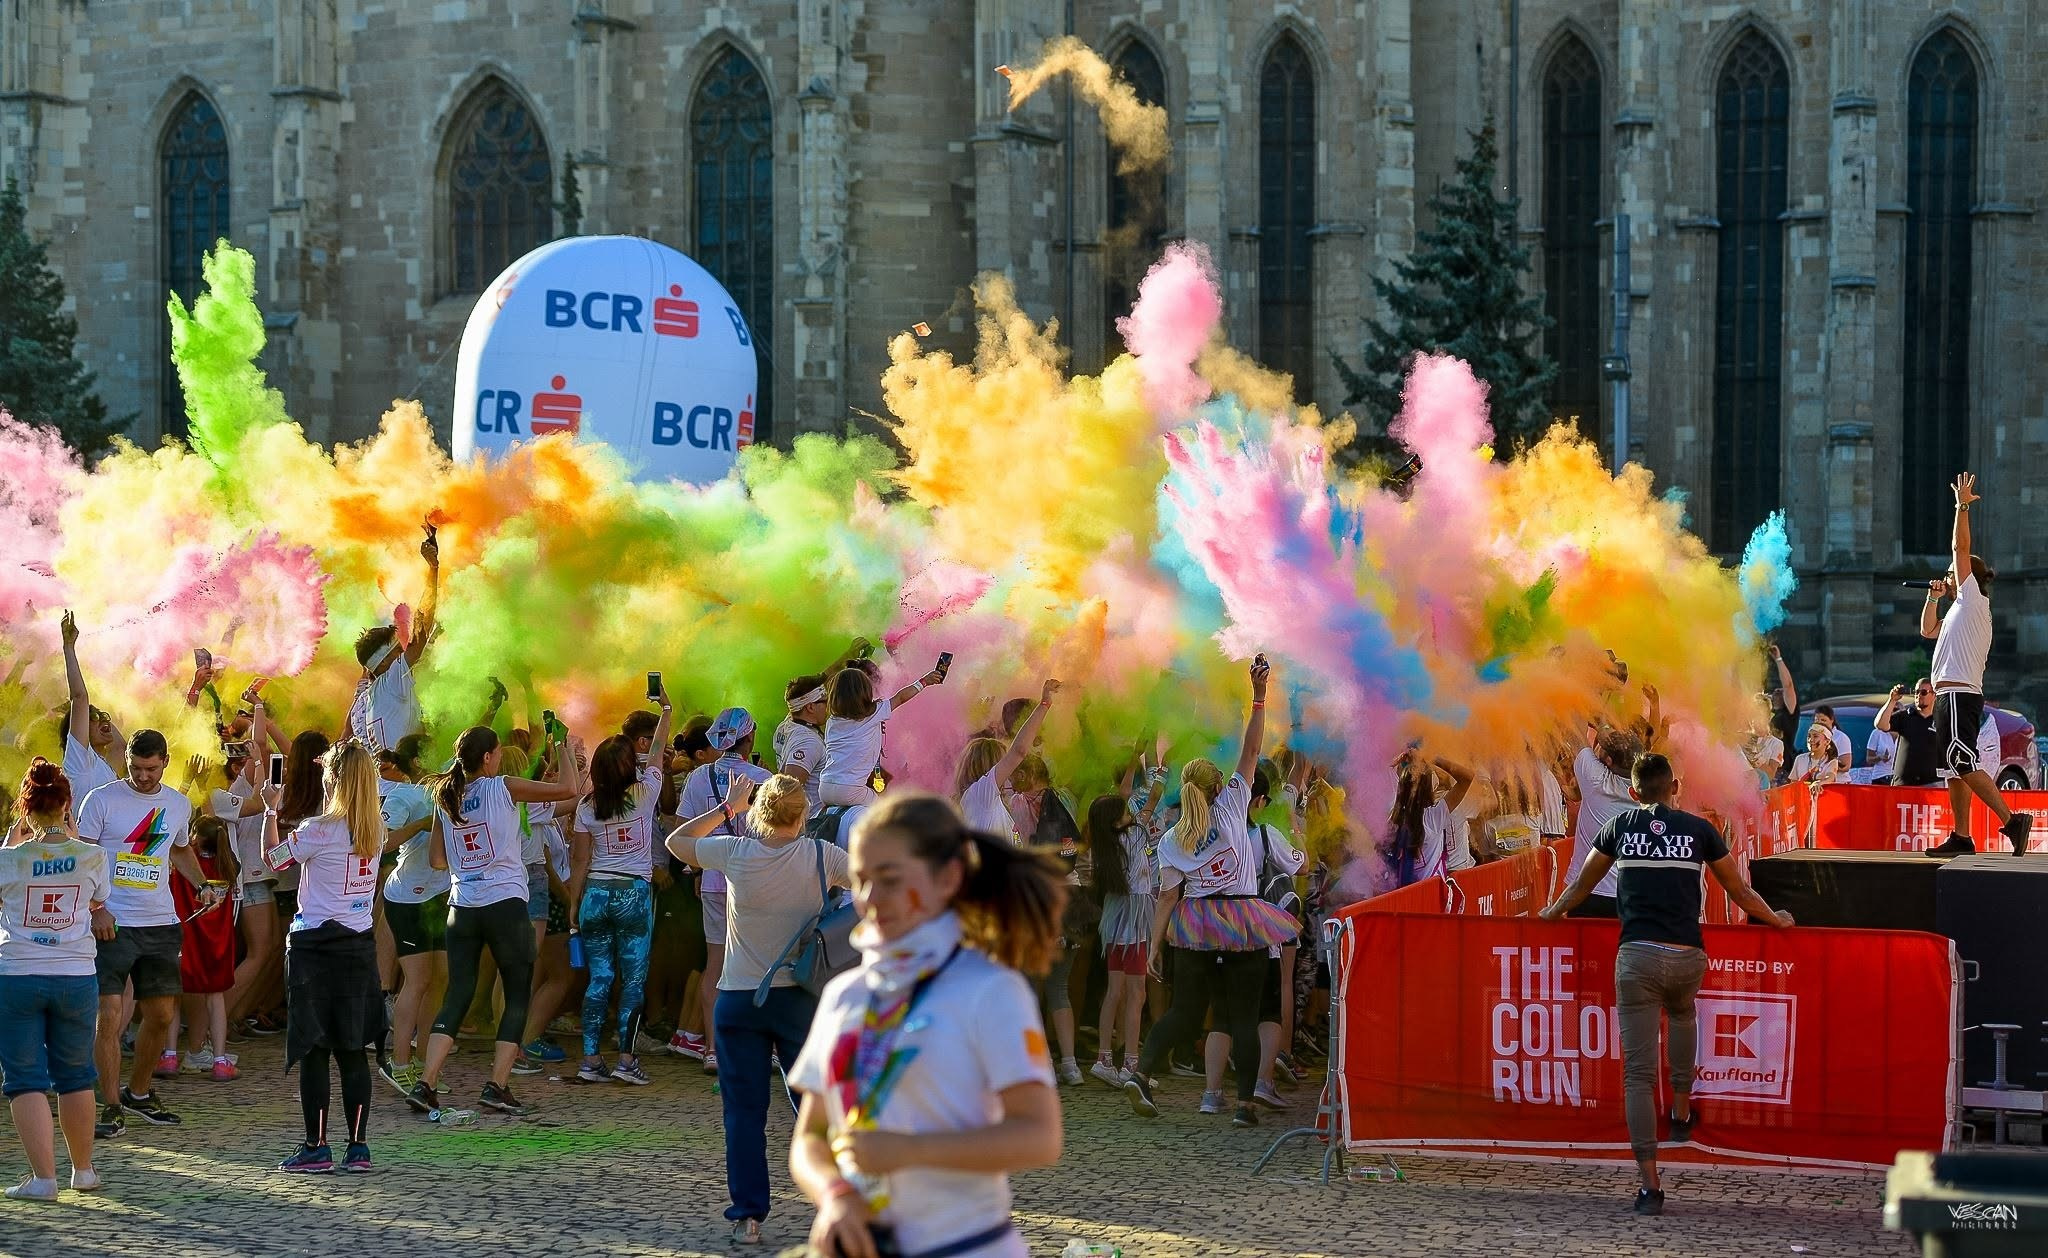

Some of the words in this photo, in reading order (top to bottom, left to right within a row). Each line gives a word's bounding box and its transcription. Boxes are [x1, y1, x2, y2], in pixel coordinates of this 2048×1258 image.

[545, 289, 643, 333] BCR
[475, 389, 521, 434] CR
[652, 401, 733, 451] BCR
[1897, 803, 1942, 835] THE
[1621, 843, 1693, 858] GUARD
[1623, 832, 1652, 846] ML
[1662, 835, 1694, 847] VIP
[33, 856, 77, 877] DERO
[126, 867, 149, 879] 32651
[30, 915, 71, 925] Kaufland
[1493, 947, 1574, 1001] THE
[1708, 959, 1767, 974] WERED
[1773, 961, 1794, 975] BY
[1492, 1003, 1621, 1060] COLO
[1493, 1060, 1581, 1107] RUN
[1695, 1066, 1777, 1083] Kaufland
